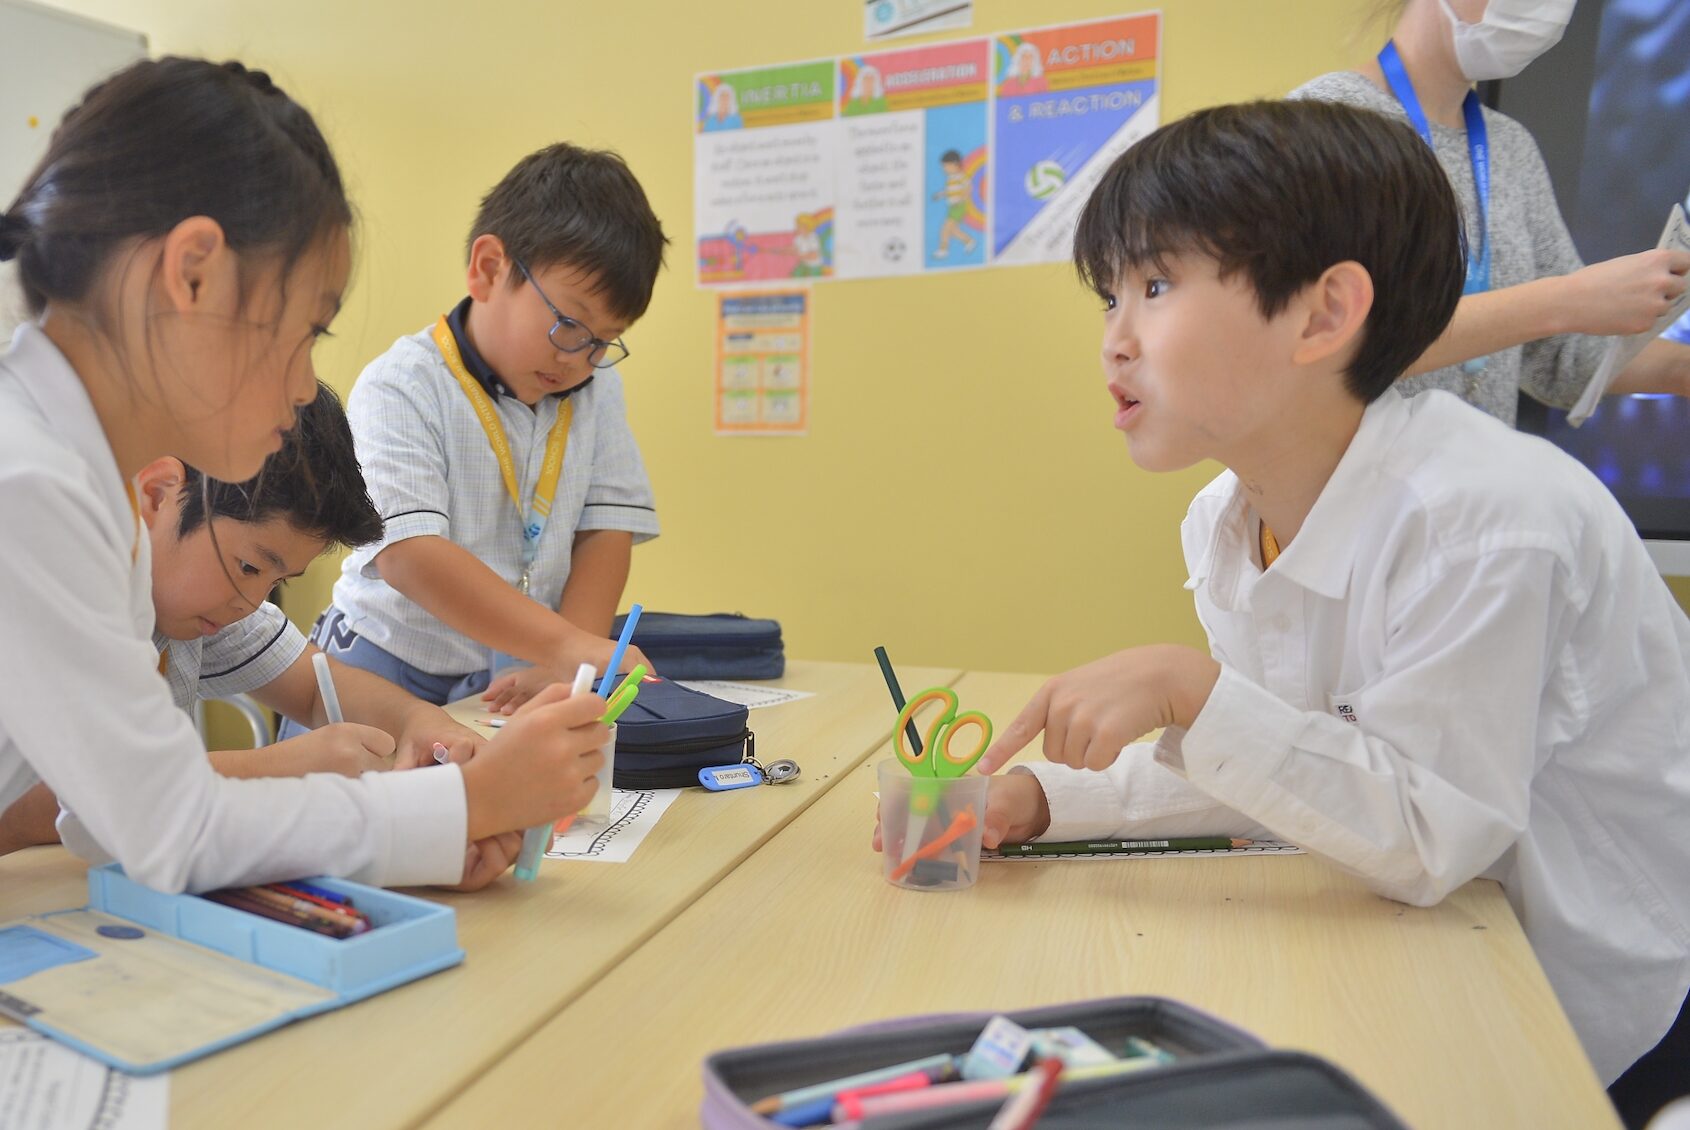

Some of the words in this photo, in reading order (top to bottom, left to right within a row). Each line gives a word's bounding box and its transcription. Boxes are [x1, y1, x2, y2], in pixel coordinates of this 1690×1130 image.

[1048, 38, 1136, 66] ACTION
[740, 81, 823, 106] INERTIA
[1008, 104, 1025, 122] &
[1028, 89, 1142, 119] REACTION
[457, 365, 497, 423] INTERNATIONAL
[488, 422, 507, 456] WORLD
